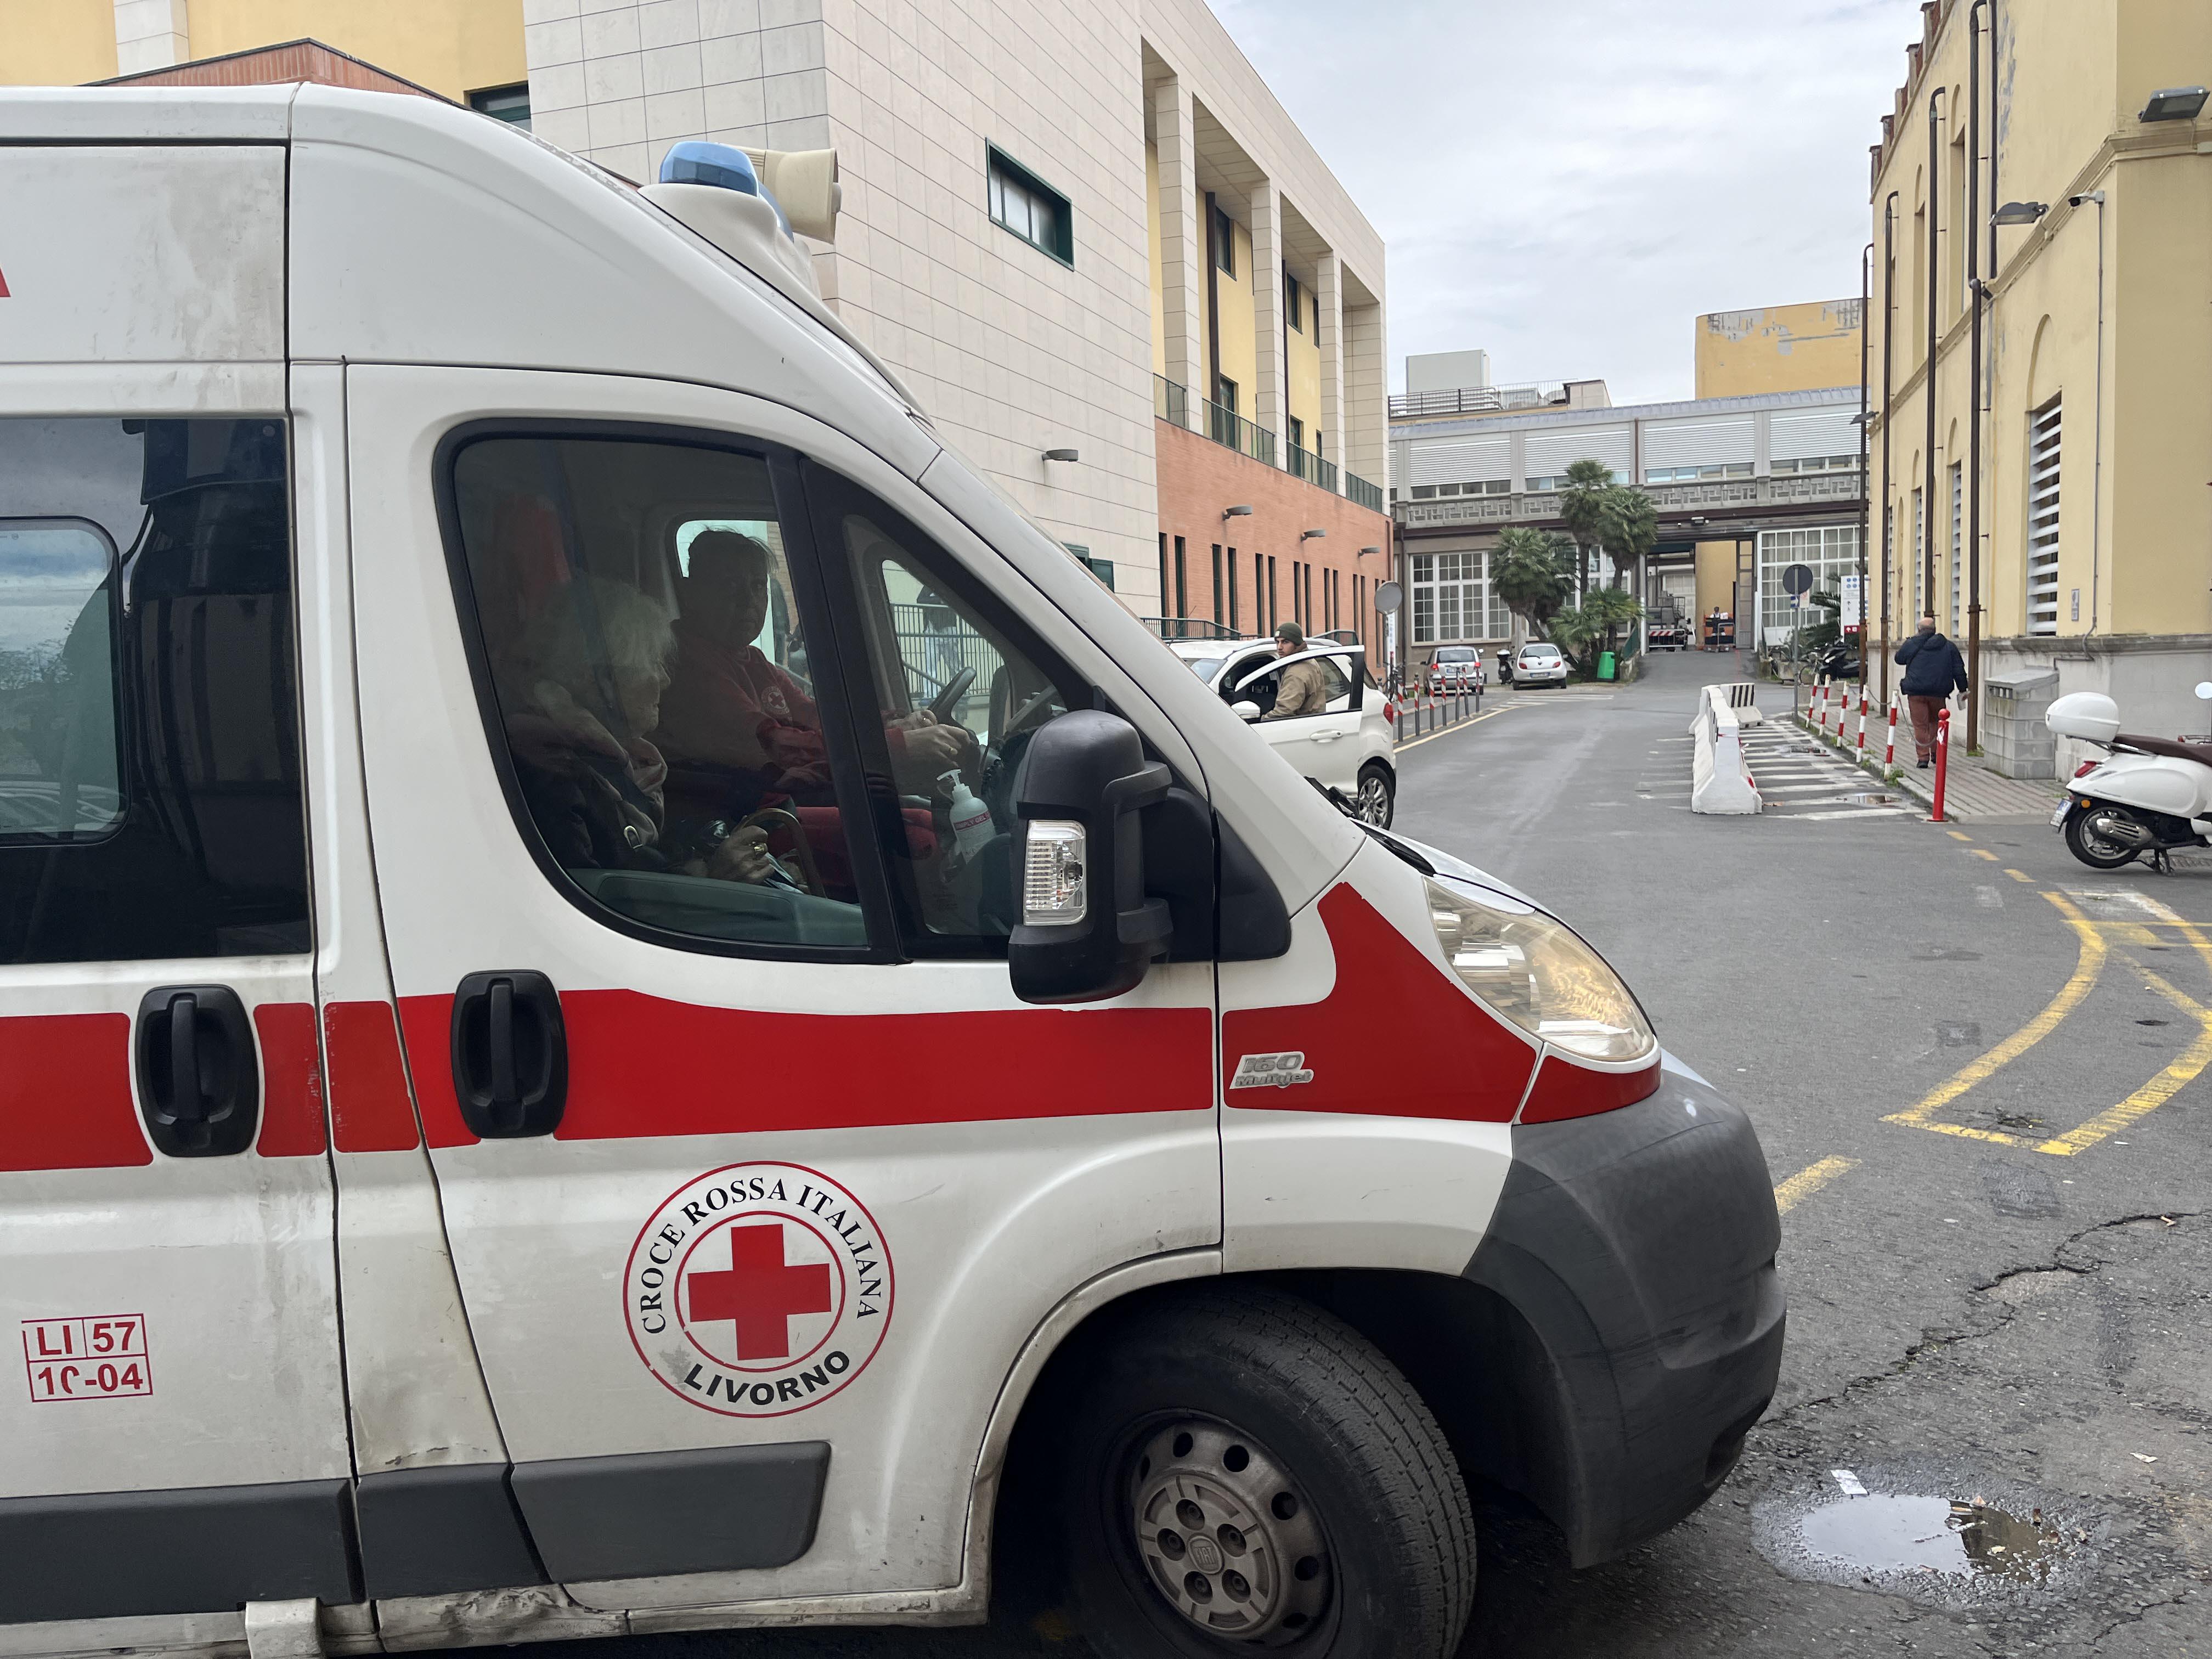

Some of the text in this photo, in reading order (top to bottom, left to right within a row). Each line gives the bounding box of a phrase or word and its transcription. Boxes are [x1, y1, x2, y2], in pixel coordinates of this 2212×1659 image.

[1243, 1053, 1301, 1073] 160
[640, 1177, 881, 1334] CROCE ROSSA ITALIANA
[37, 1322, 136, 1356] LI 57
[684, 1350, 850, 1406] LIVORNO
